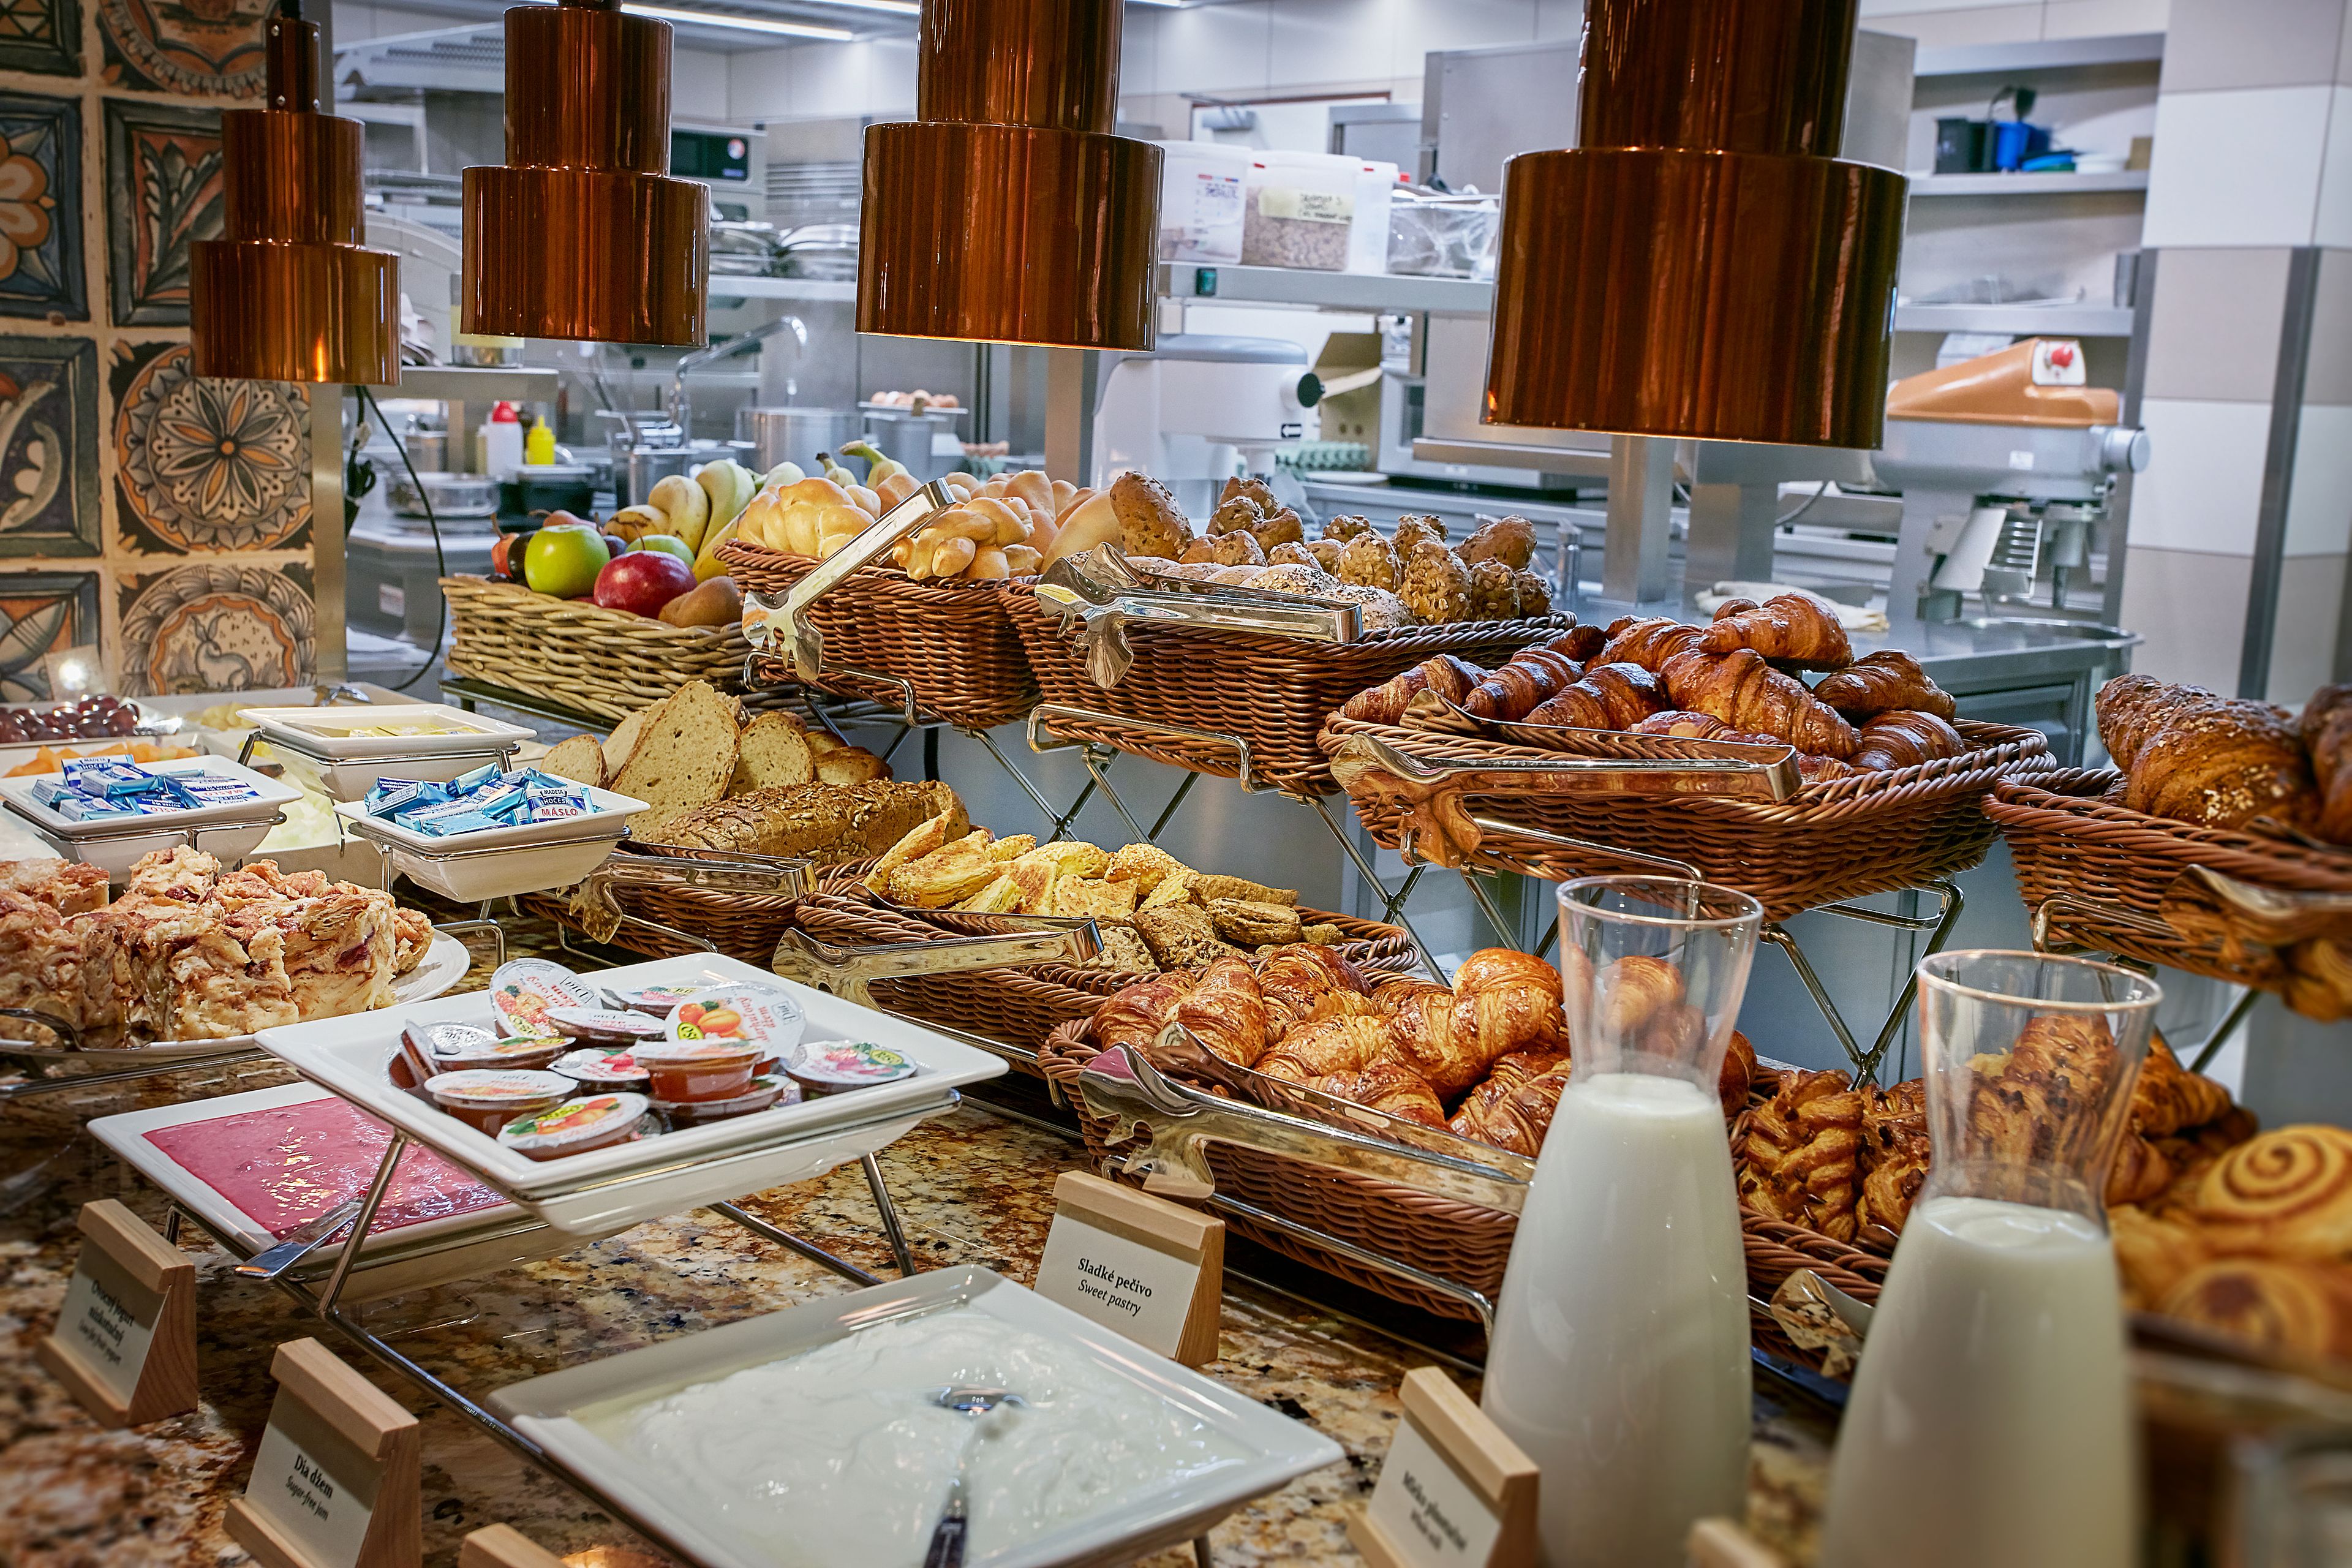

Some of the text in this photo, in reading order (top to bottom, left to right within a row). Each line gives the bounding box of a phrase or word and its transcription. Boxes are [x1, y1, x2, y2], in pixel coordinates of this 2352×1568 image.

[541, 807, 578, 816] MÁSLO
[1078, 1257, 1152, 1297] Sladké pečivo
[1078, 1279, 1141, 1317] Sweet pastry
[294, 1454, 333, 1499] Dia džem
[285, 1475, 329, 1522] Sugar-free jam
